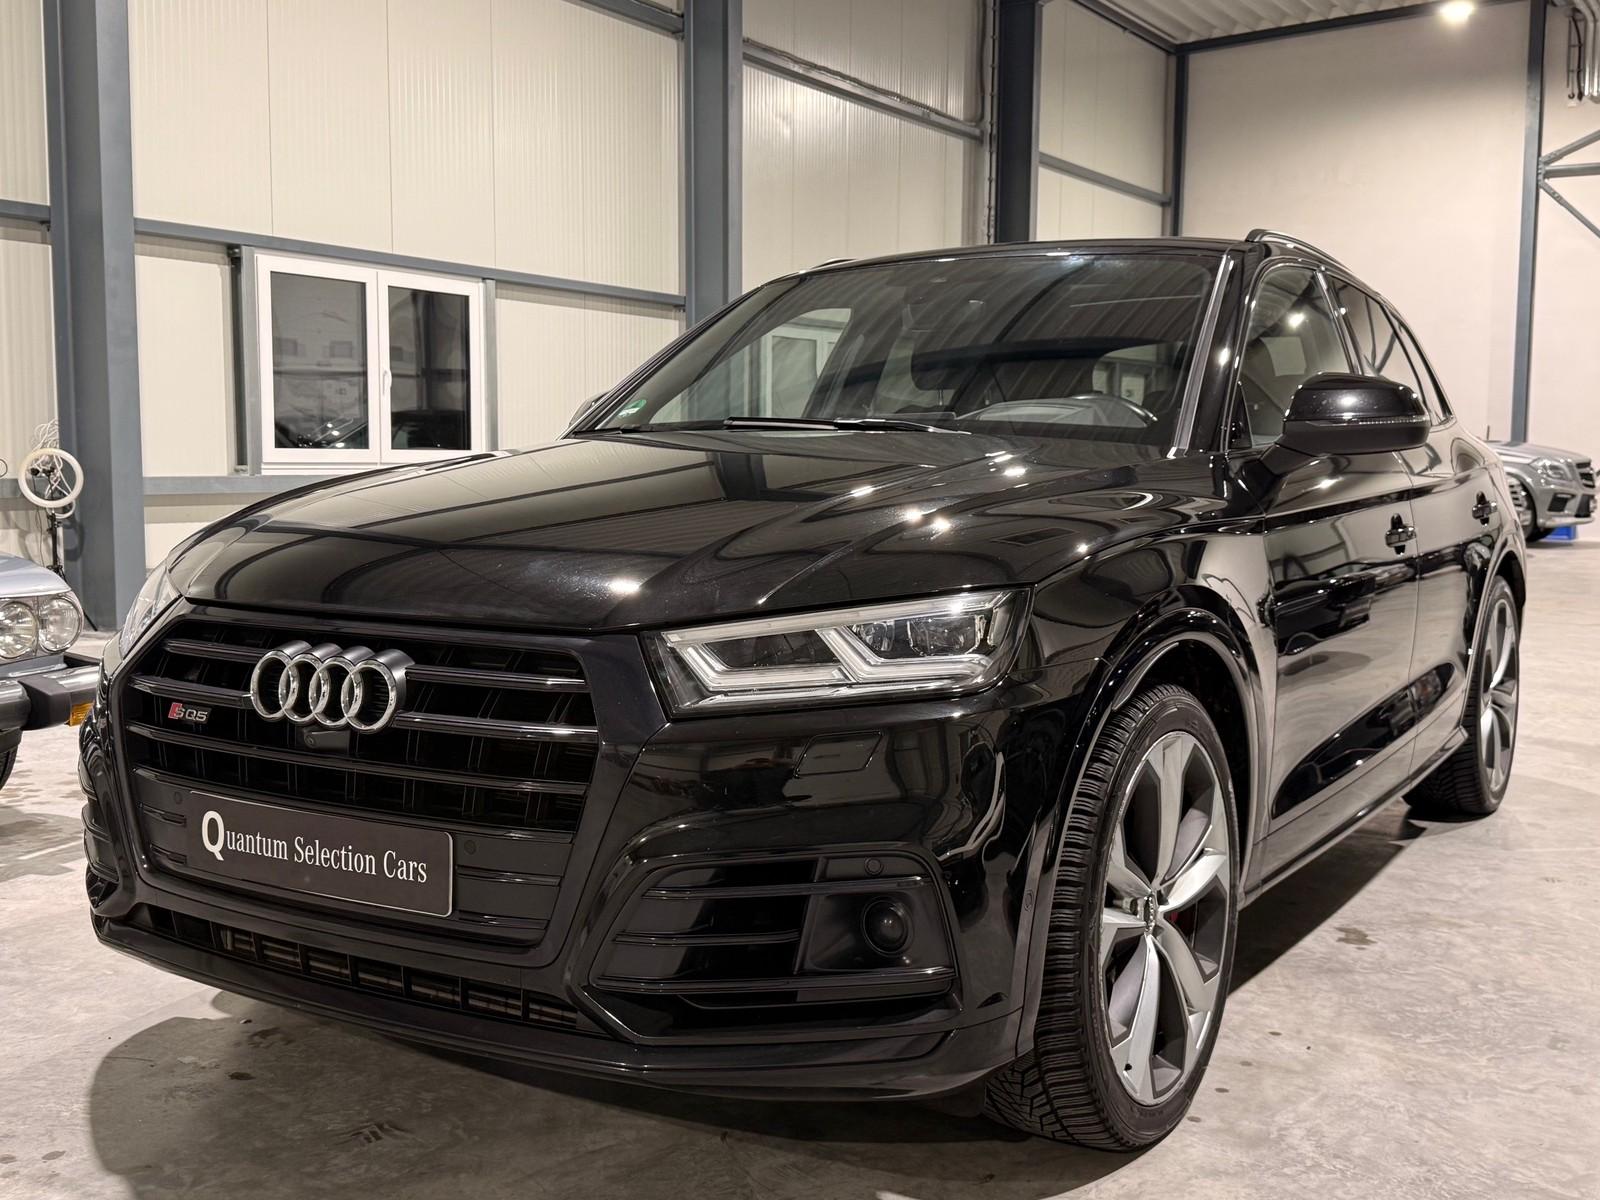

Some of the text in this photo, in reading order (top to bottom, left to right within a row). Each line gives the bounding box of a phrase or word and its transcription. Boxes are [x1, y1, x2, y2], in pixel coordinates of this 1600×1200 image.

[172, 704, 208, 721] SQ5
[201, 811, 427, 883] Quantum Selection Cars
